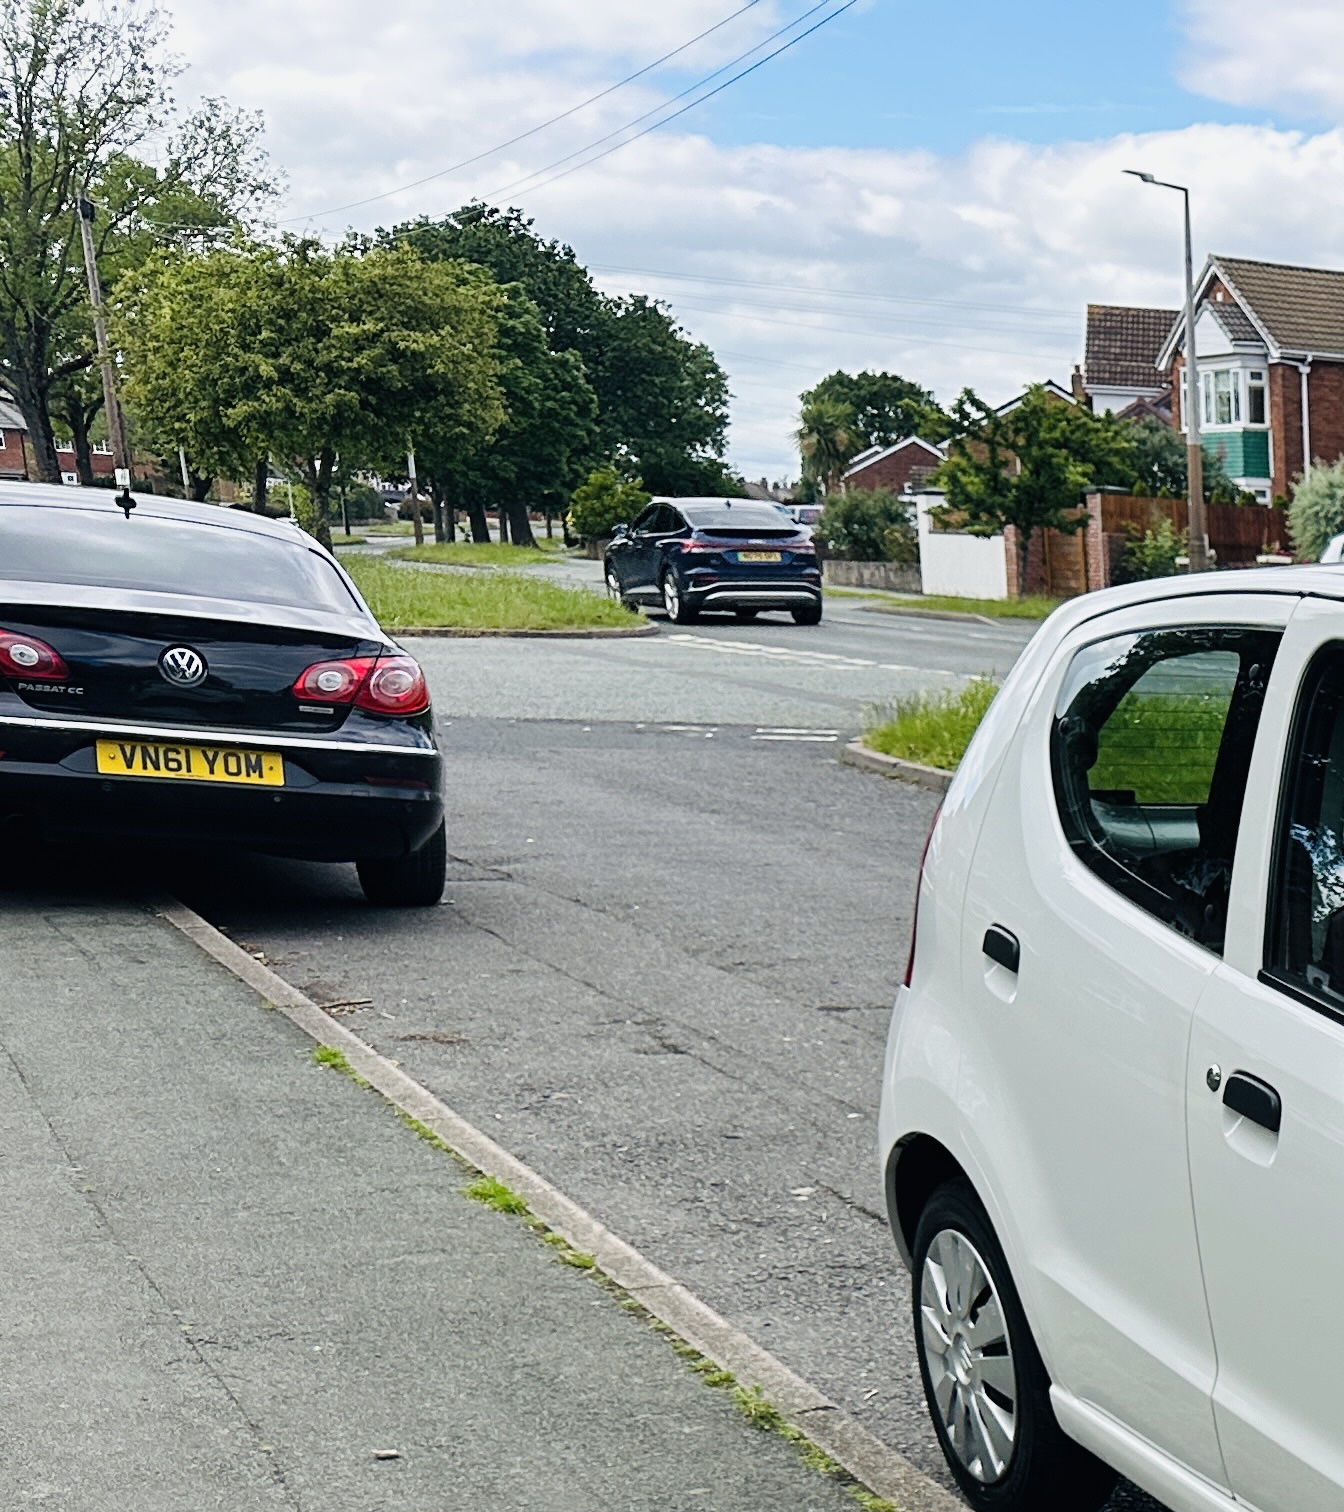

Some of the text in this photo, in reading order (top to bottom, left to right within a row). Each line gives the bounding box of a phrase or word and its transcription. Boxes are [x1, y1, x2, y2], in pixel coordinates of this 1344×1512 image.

[18, 682, 84, 695] PASSAT CC
[119, 743, 265, 779] VN61 YOM
